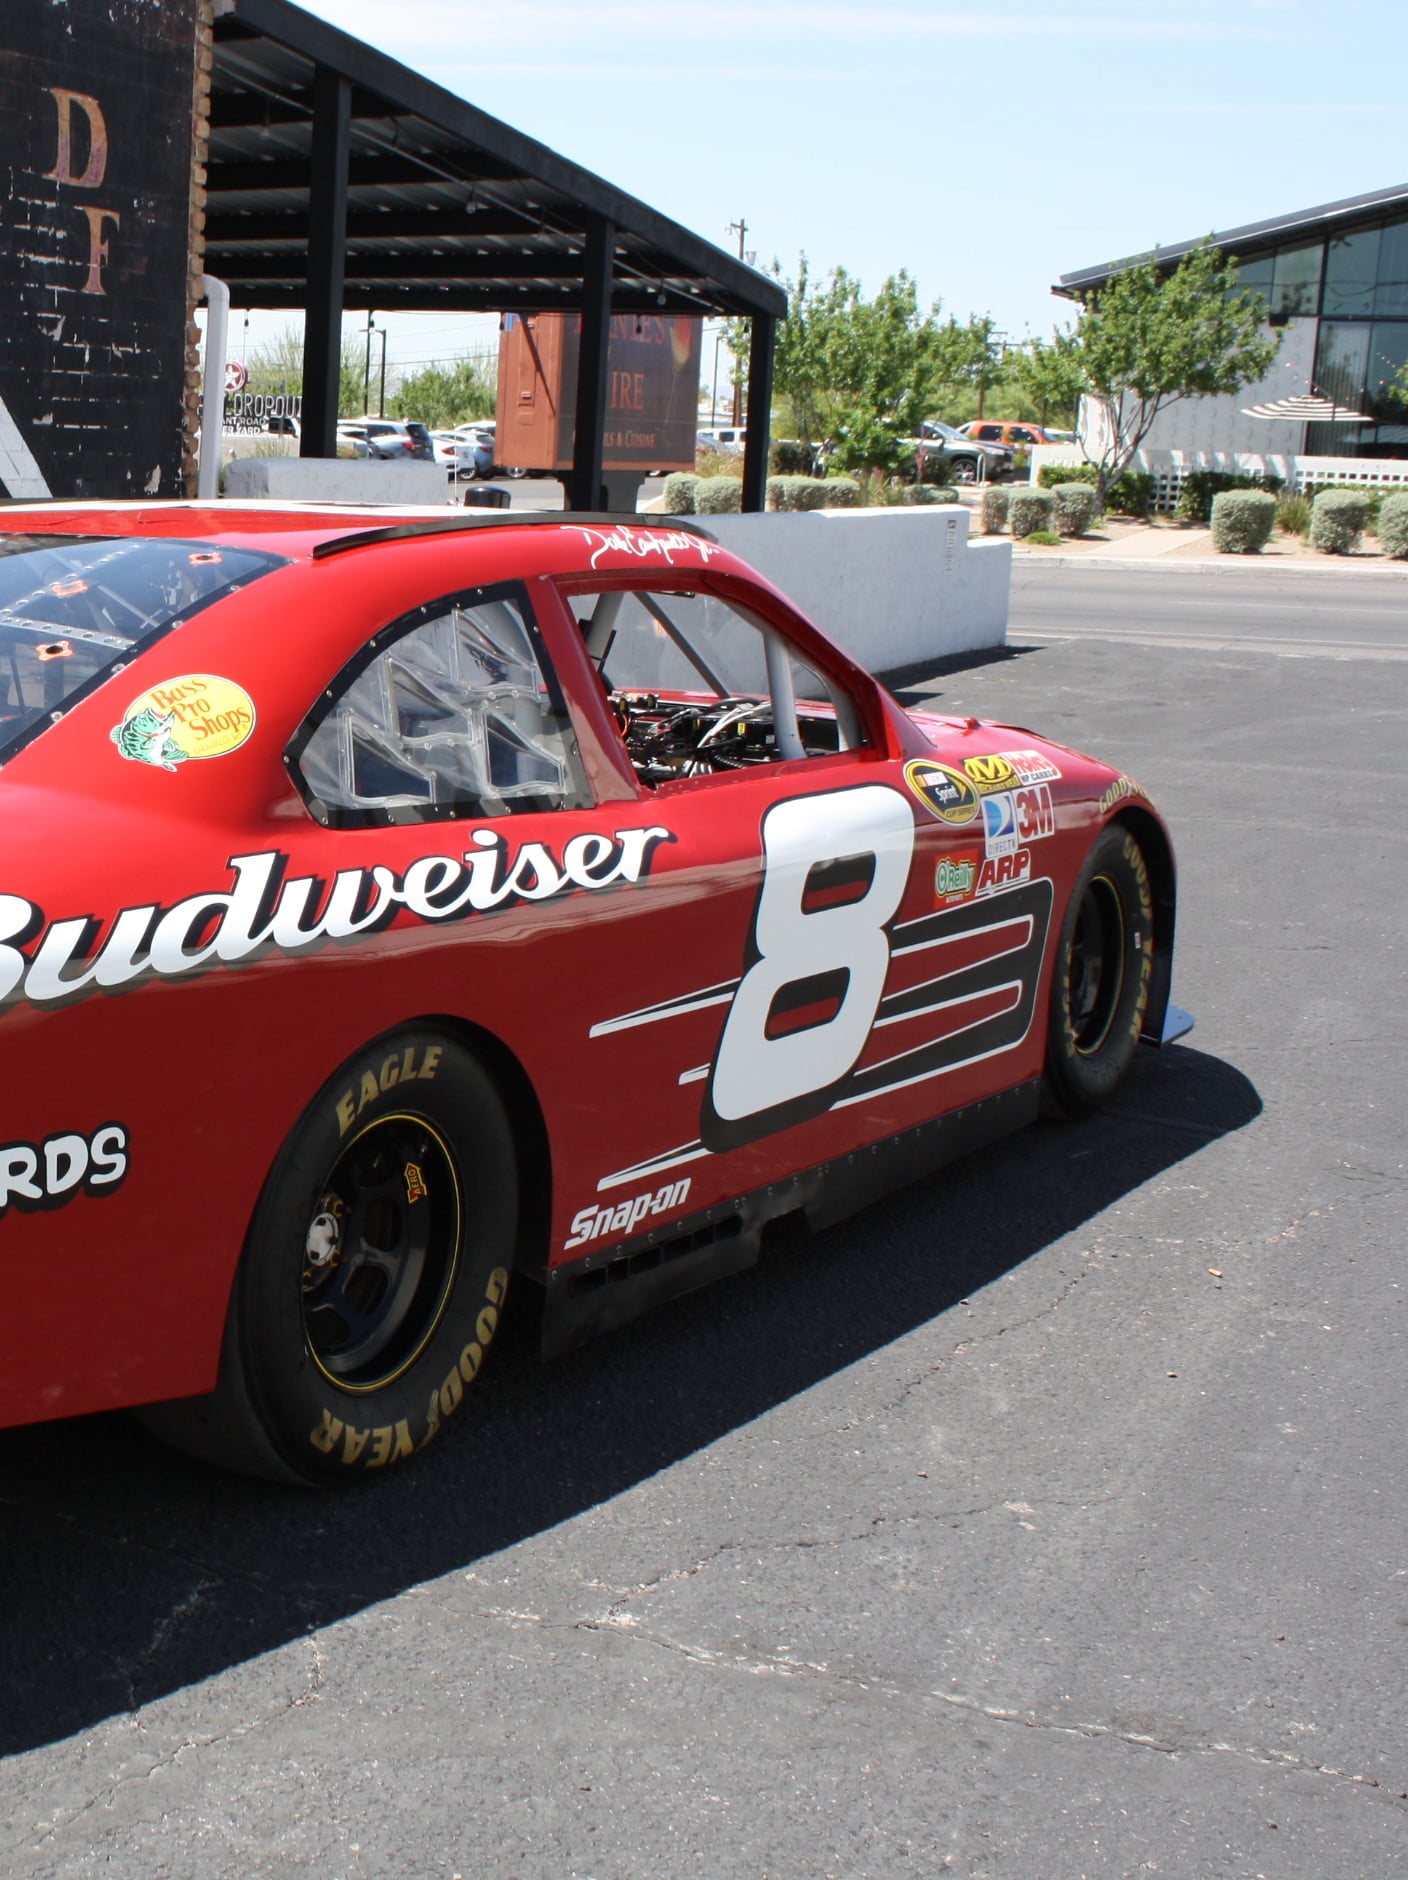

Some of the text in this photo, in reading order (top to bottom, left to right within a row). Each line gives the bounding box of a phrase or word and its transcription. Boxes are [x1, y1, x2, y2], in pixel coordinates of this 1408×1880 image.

[43, 87, 108, 188] D
[75, 205, 120, 294] F
[610, 371, 645, 411] IRE
[239, 417, 266, 426] ROAD
[150, 679, 207, 709] Bass
[171, 699, 210, 723] Pro
[189, 707, 250, 740] Shops
[935, 785, 959, 804] Sprint
[1016, 787, 1054, 839] 3M
[978, 851, 1030, 889] ARP
[710, 783, 917, 1122] 8
[335, 1046, 443, 1138] EAGLE
[408, 1170, 422, 1194] AERO
[564, 1178, 692, 1250] Snap-on
